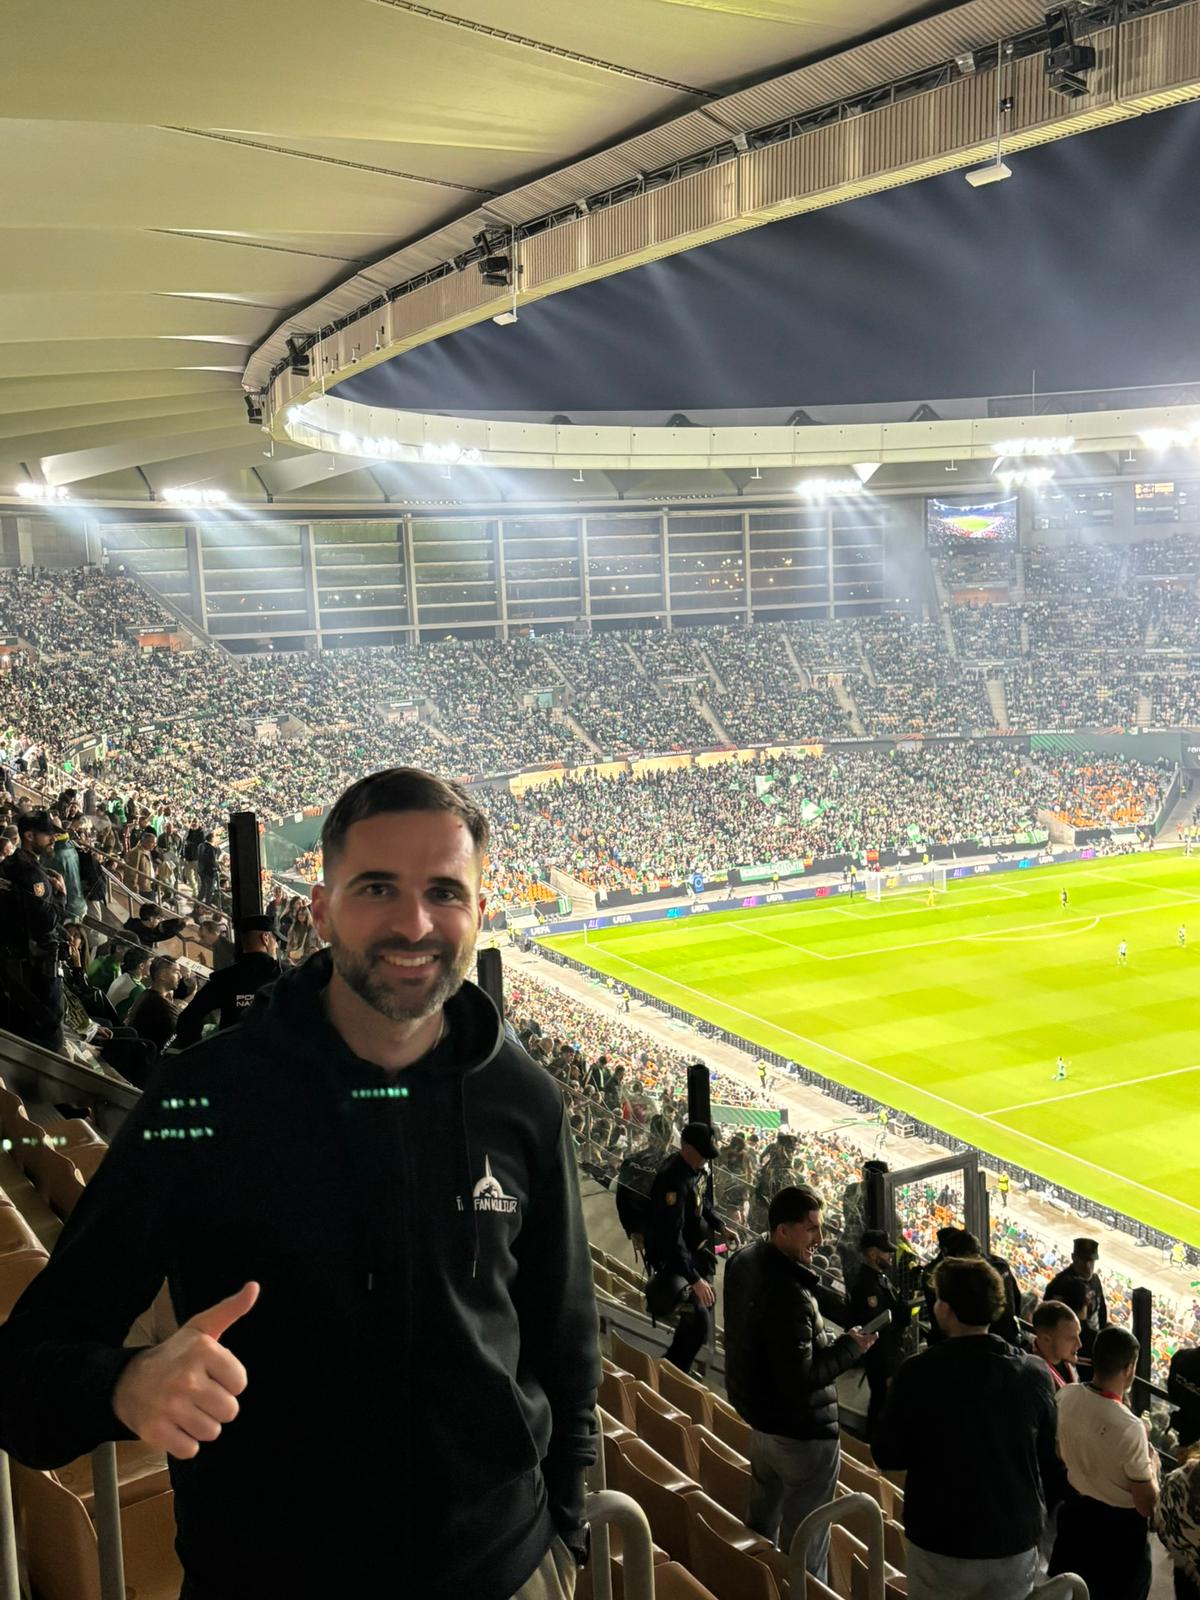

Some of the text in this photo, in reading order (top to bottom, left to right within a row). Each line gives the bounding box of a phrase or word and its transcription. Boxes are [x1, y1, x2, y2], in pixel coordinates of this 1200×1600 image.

[766, 893, 784, 902] UEFA
[691, 904, 709, 913] UEFA
[613, 915, 632, 924] UEFA
[530, 926, 550, 936] UEFA
